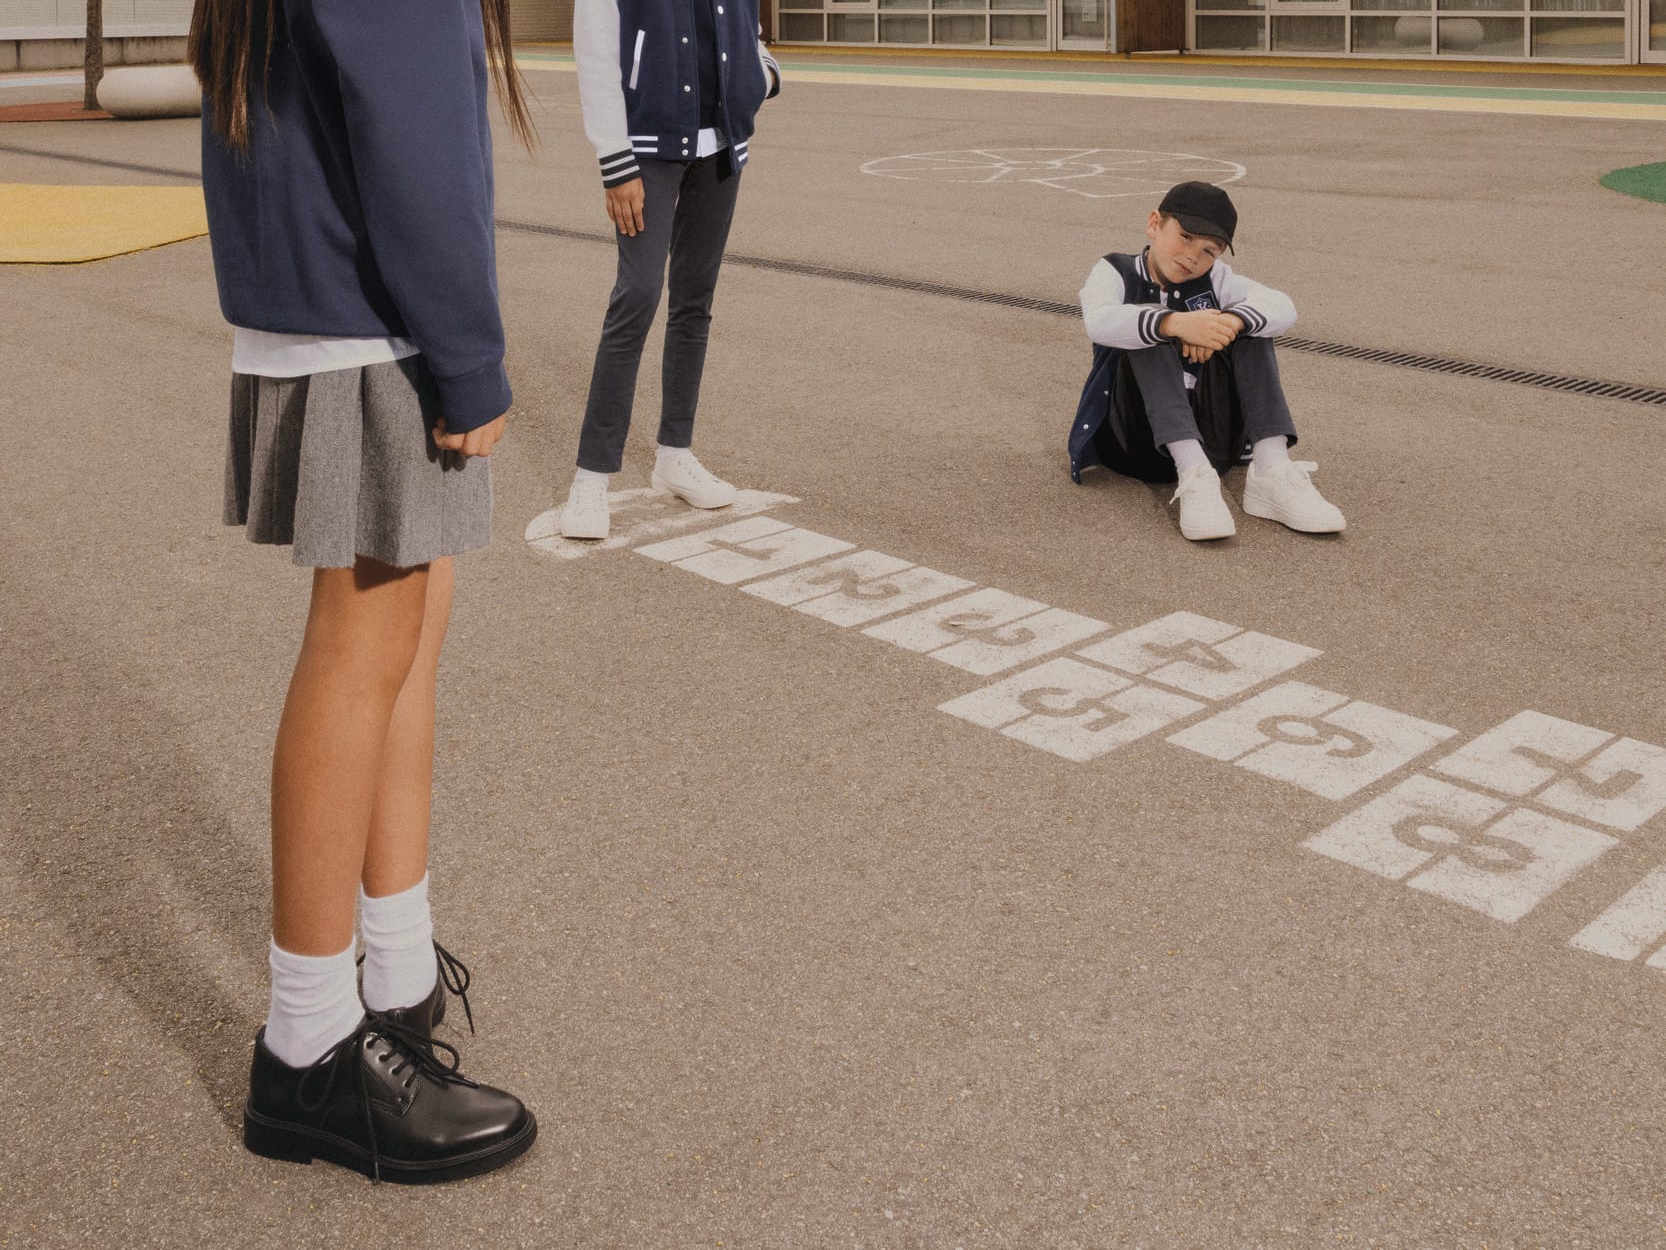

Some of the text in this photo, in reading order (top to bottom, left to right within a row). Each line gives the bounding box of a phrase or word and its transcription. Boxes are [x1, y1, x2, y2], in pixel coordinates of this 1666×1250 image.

[708, 538, 783, 561] 1
[804, 570, 899, 600] 2
[939, 612, 1035, 647] 3
[1141, 638, 1241, 672] 4
[1018, 687, 1130, 730] 5
[1257, 714, 1374, 758] 6
[1510, 746, 1645, 800] 7
[1390, 812, 1537, 872] 8
